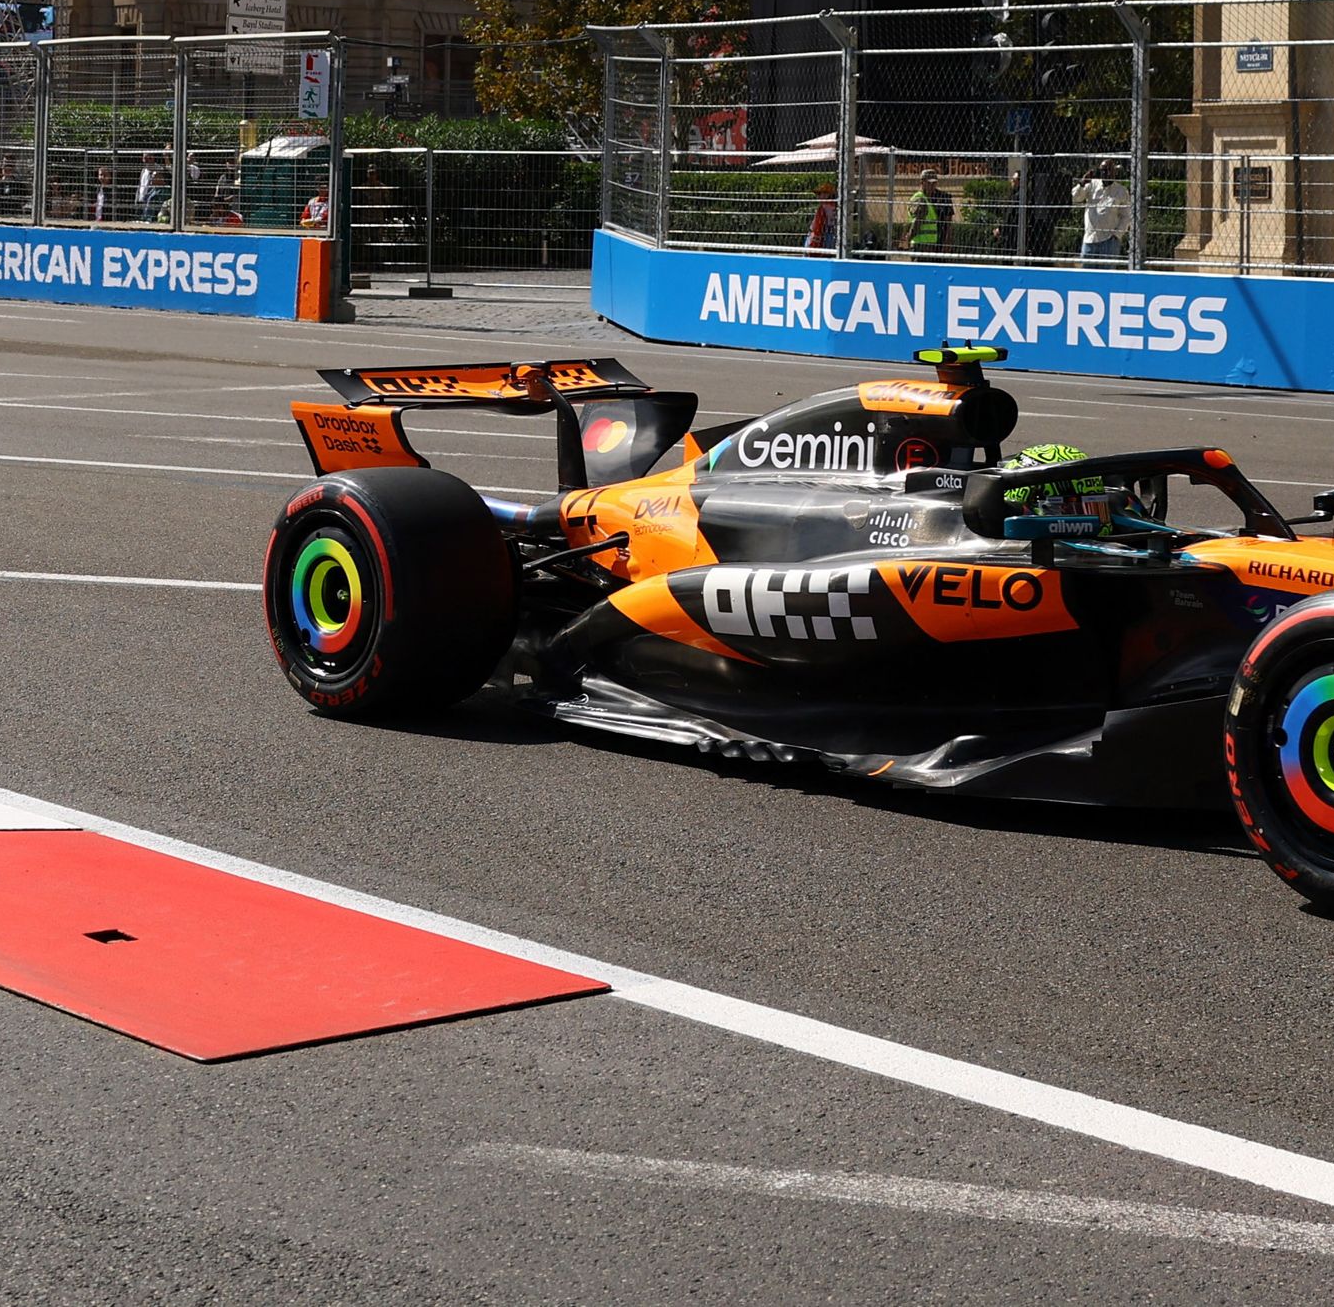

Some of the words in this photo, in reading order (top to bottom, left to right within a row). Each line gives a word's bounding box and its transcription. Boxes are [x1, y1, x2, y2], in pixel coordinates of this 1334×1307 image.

[245, 3, 265, 14] Iceberg
[266, 5, 282, 13] Hotel
[102, 247, 258, 296] EXPRESS
[700, 272, 925, 337] AMERICAN
[946, 285, 1228, 355] EXPRESS
[315, 412, 379, 436] Dropbox
[324, 434, 365, 453] Dash
[738, 421, 876, 471] Gemini
[935, 474, 963, 489] okta
[286, 485, 325, 517] PIRELLI
[634, 496, 683, 520] DELL
[1048, 519, 1093, 535] allwyn
[1248, 560, 1334, 587] RICHARD
[897, 565, 1043, 612] VELO
[1225, 732, 1271, 852] ZERO
